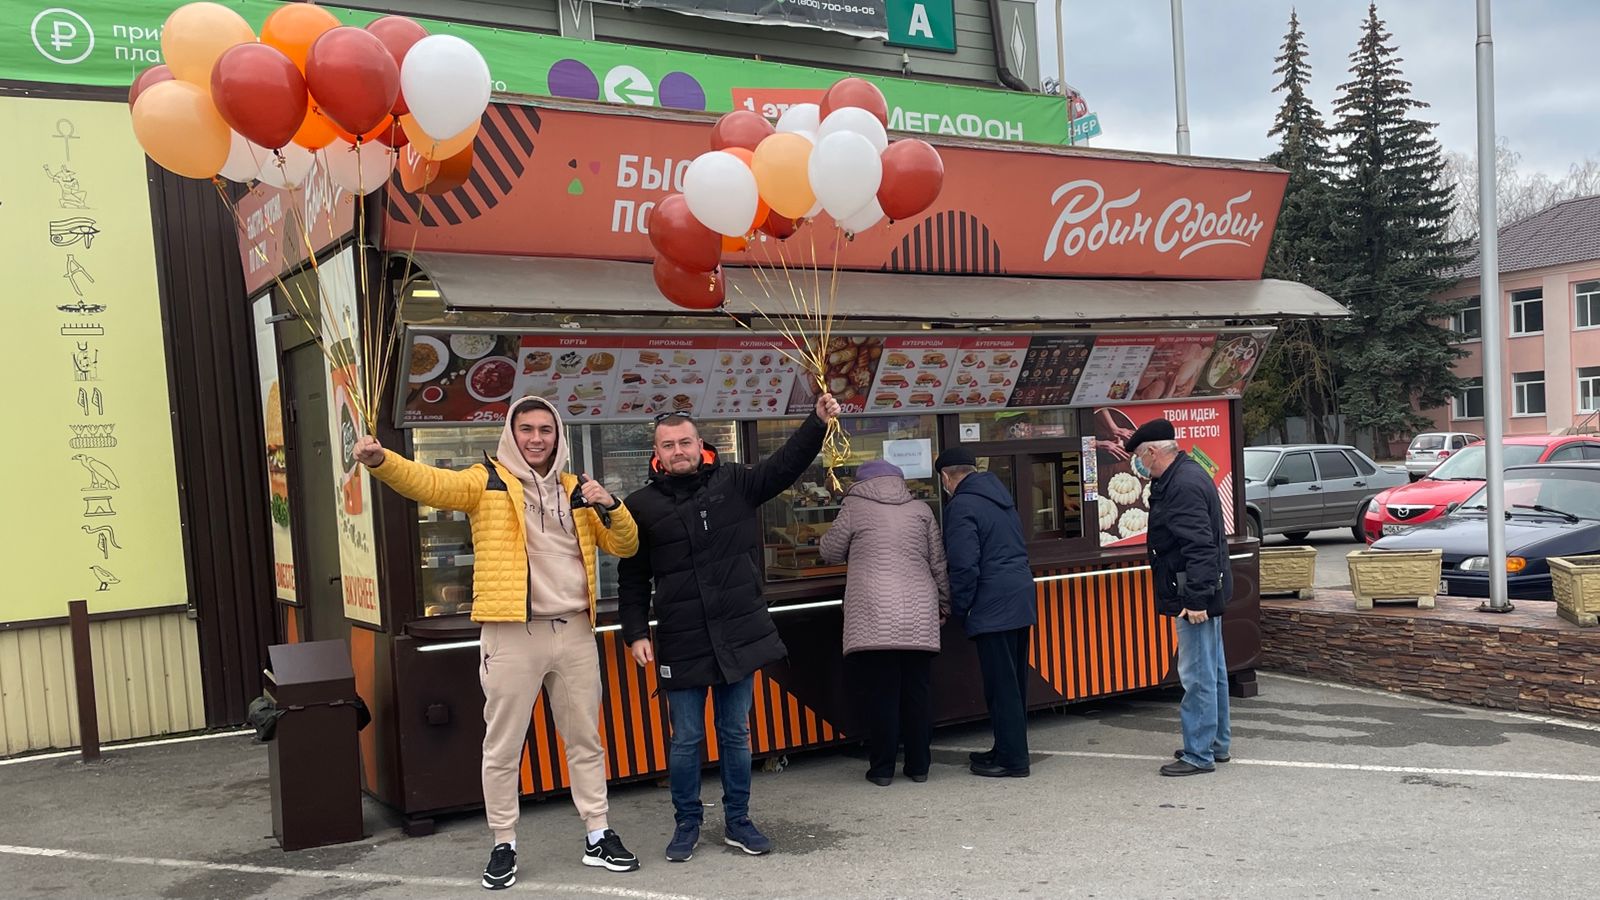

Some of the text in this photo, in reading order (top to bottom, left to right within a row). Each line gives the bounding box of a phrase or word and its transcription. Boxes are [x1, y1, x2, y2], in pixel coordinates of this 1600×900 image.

[112, 24, 165, 44] при
[115, 46, 161, 63] пла
[616, 154, 693, 193] БЫС
[1043, 179, 1264, 261] Робин Сдобин
[1163, 409, 1188, 421] ТВОИ
[1174, 425, 1220, 439] ШЕ ТЕСТО!
